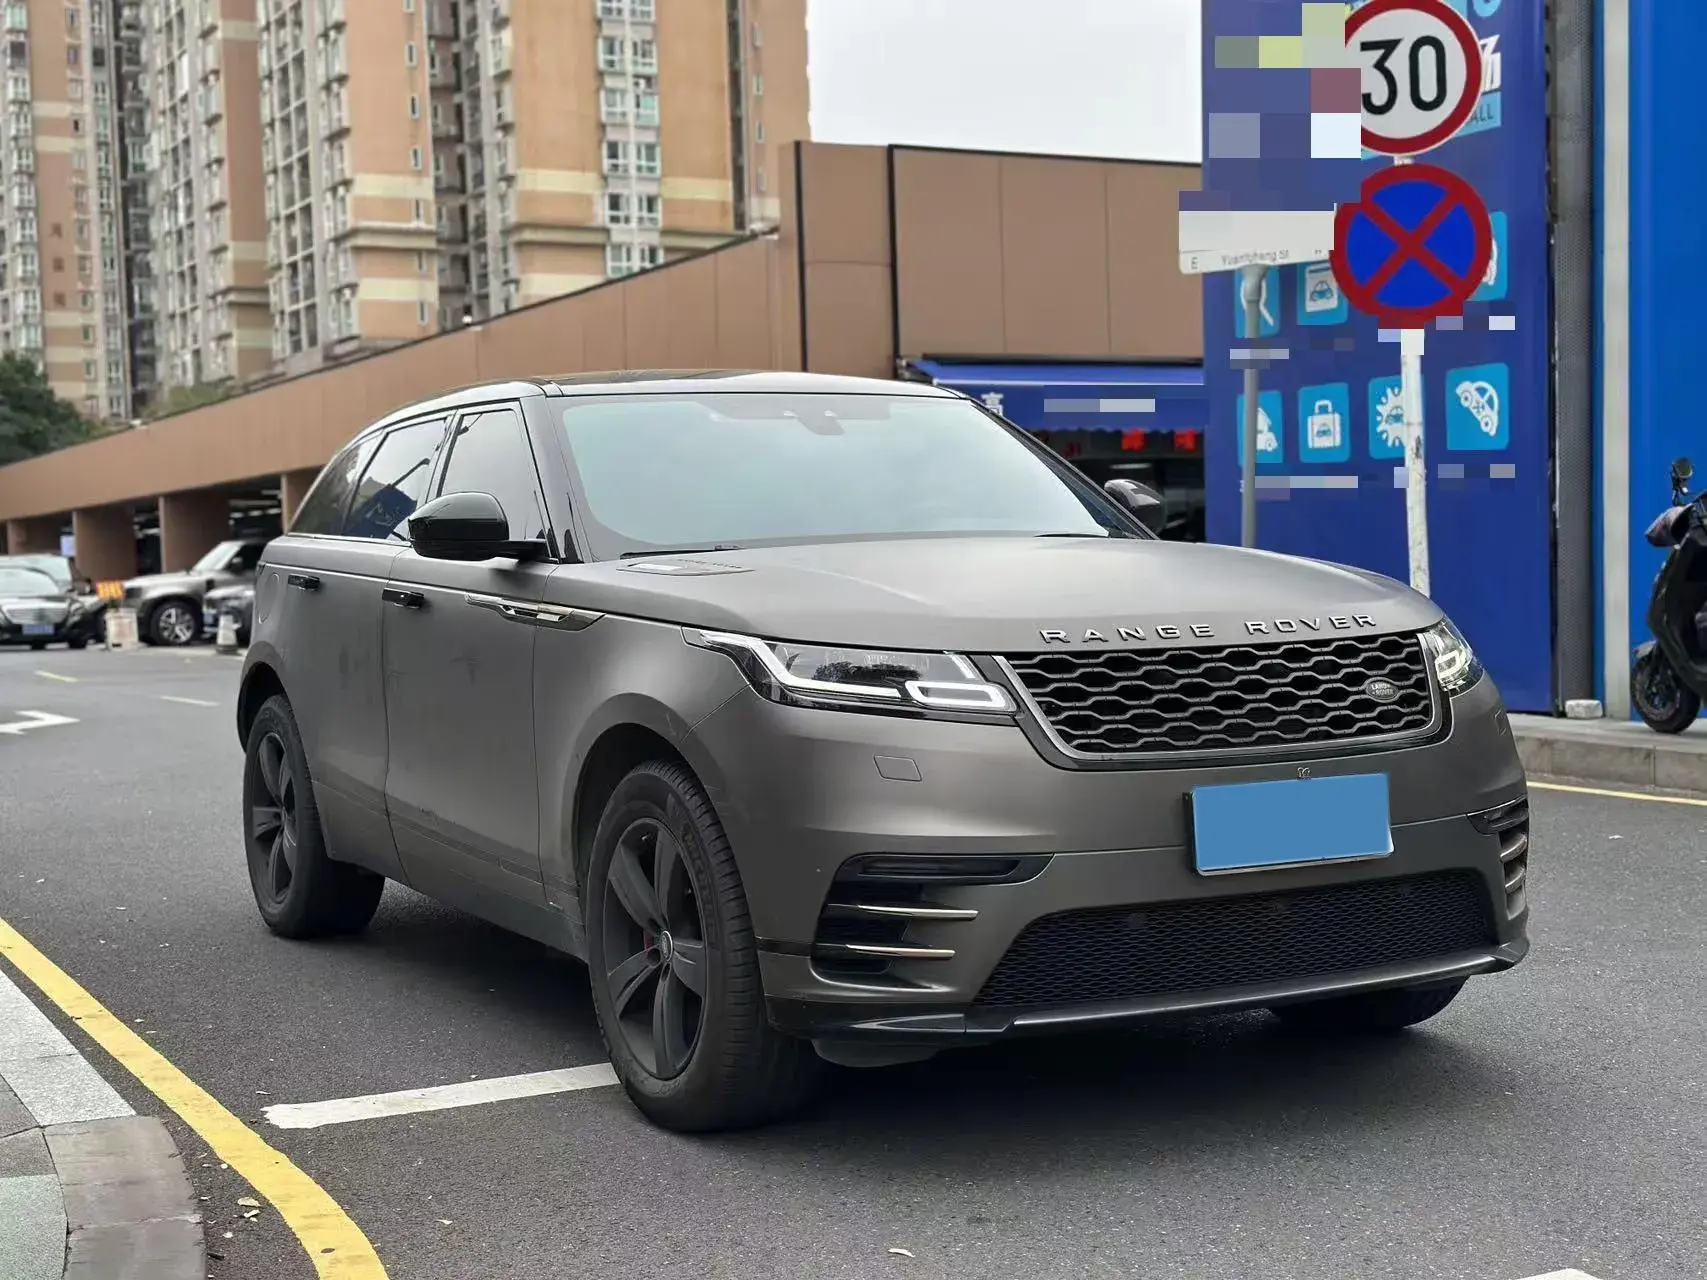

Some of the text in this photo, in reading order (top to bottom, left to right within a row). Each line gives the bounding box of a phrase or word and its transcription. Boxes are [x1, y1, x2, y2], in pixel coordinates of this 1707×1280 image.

[1360, 35, 1447, 116] 30
[1040, 614, 1377, 644] RANGE ROVER
